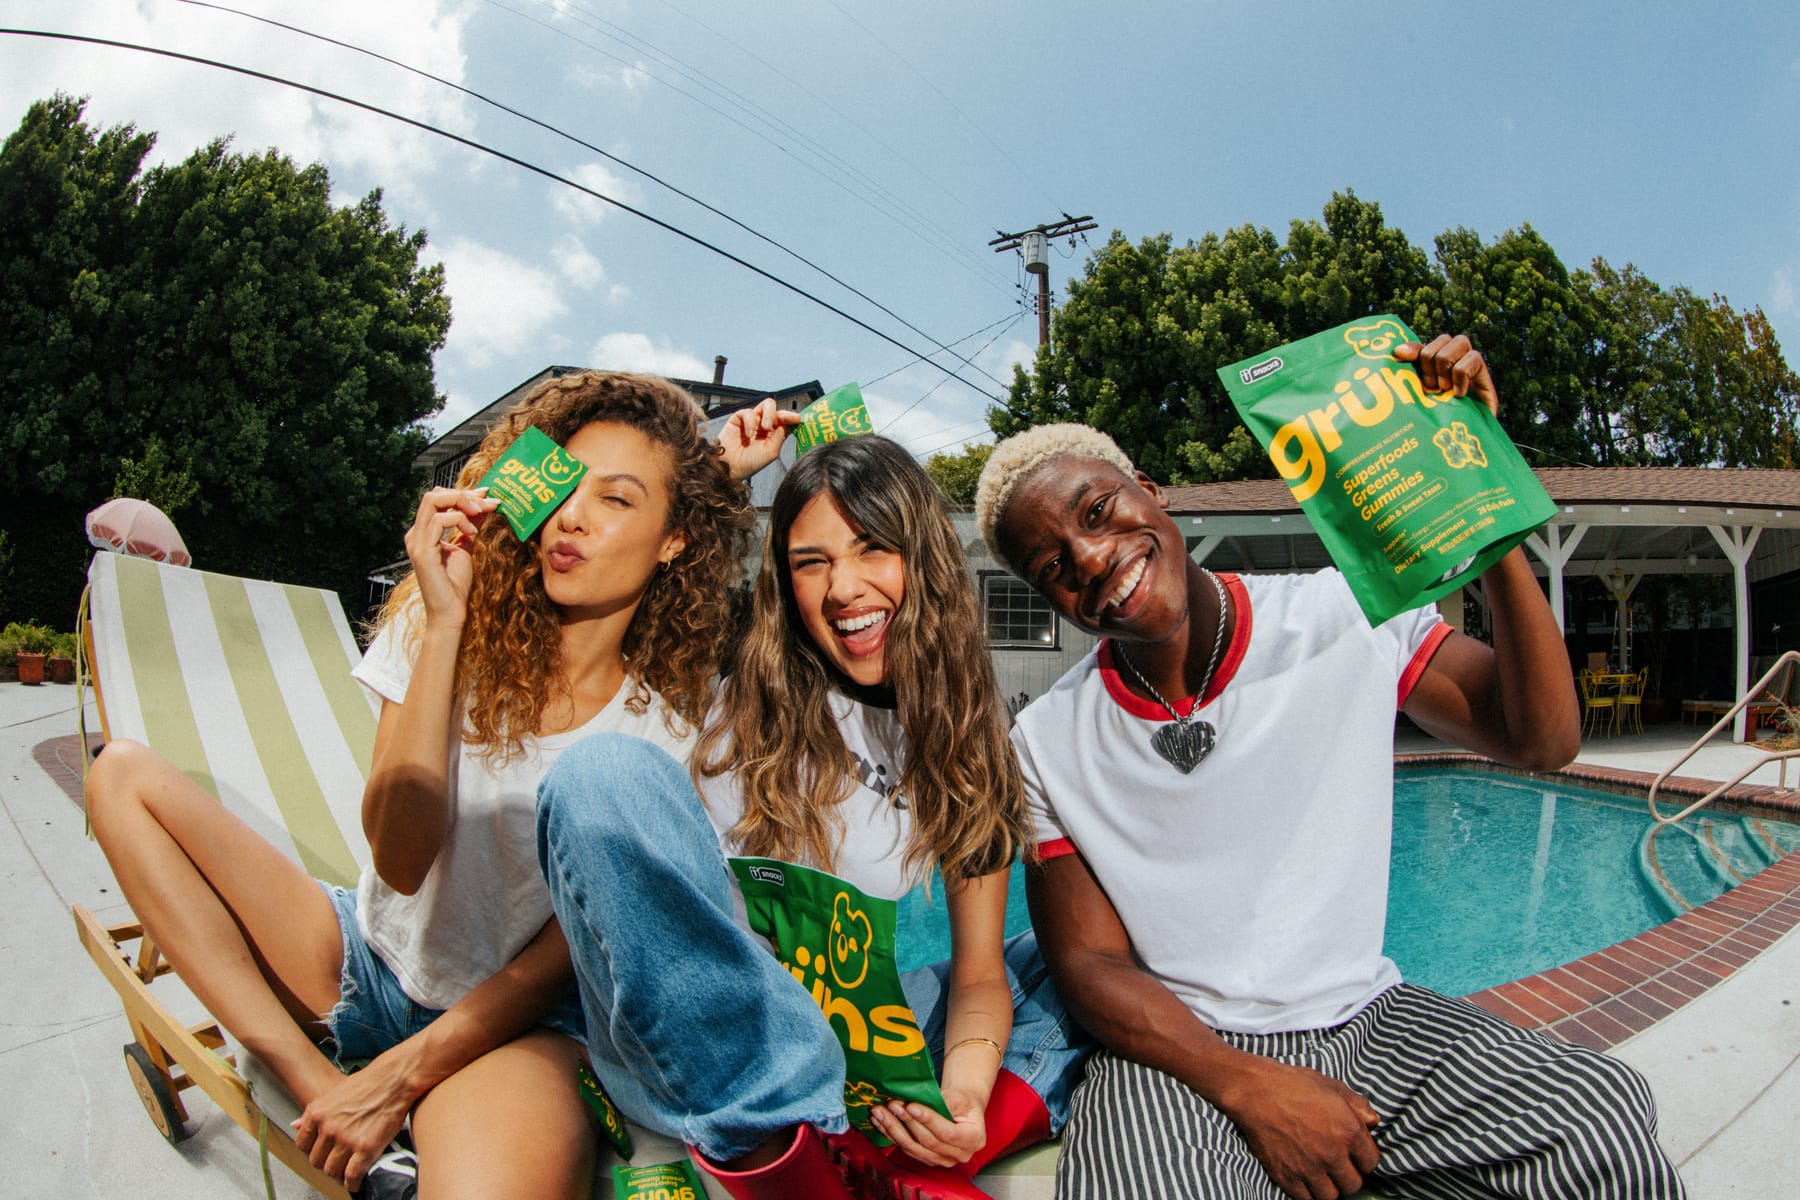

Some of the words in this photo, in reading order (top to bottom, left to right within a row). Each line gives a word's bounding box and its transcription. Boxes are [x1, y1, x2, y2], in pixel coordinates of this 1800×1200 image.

[498, 458, 556, 504] grüns
[1343, 437, 1419, 495] Superfoods
[1352, 468, 1399, 507] Greens
[1361, 471, 1424, 521] Gummies
[1377, 514, 1395, 532] Fresh
[1402, 496, 1423, 512] Sweet
[1423, 483, 1441, 497] Taste
[1394, 550, 1420, 574] Dietary
[1420, 519, 1466, 552] Supplement
